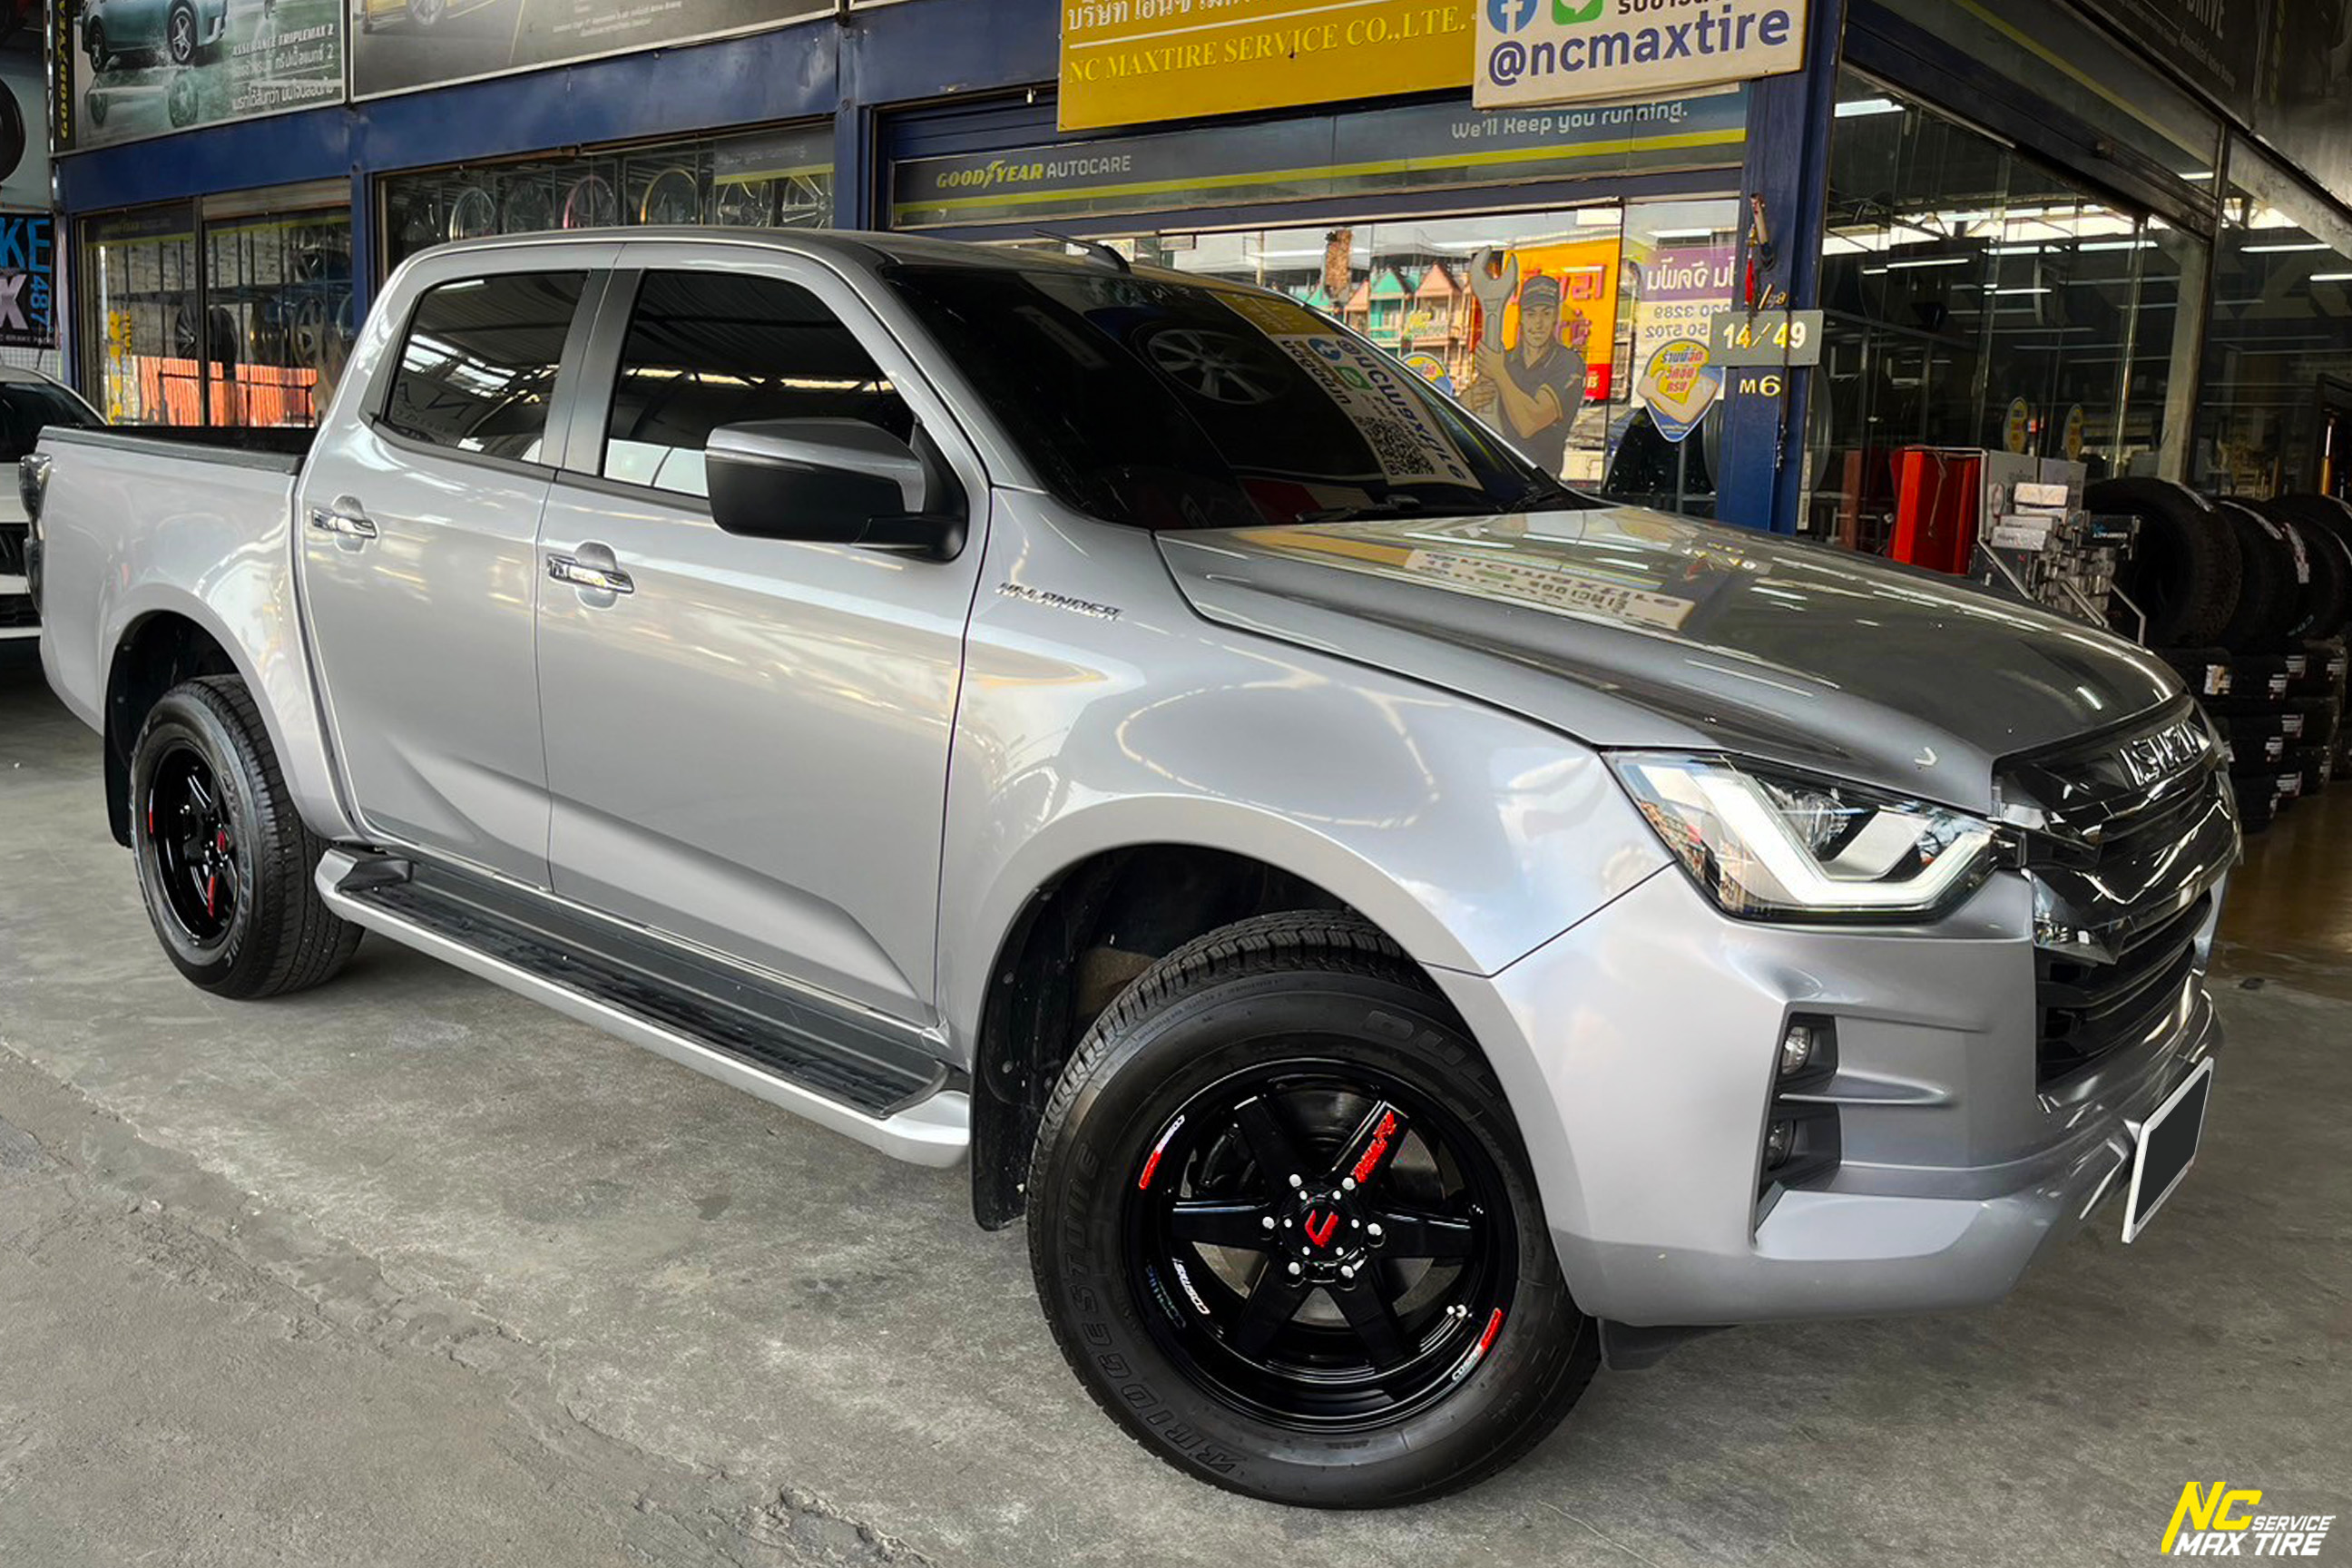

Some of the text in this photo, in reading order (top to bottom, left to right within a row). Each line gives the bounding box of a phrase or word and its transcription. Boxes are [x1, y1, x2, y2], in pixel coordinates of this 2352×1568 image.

[328, 23, 334, 36] 2
[1069, 58, 1100, 83] NC
[1106, 42, 1218, 79] MAXTIRE
[1224, 24, 1338, 64] SERVICE
[1488, 5, 1790, 87] @ncmaxtire
[1452, 122, 1497, 139] We'll
[1558, 113, 1595, 133] you
[1602, 102, 1688, 125] running.
[936, 155, 1131, 188] GOODYEAR AUTOCARE
[2119, 723, 2197, 787] ISUZU
